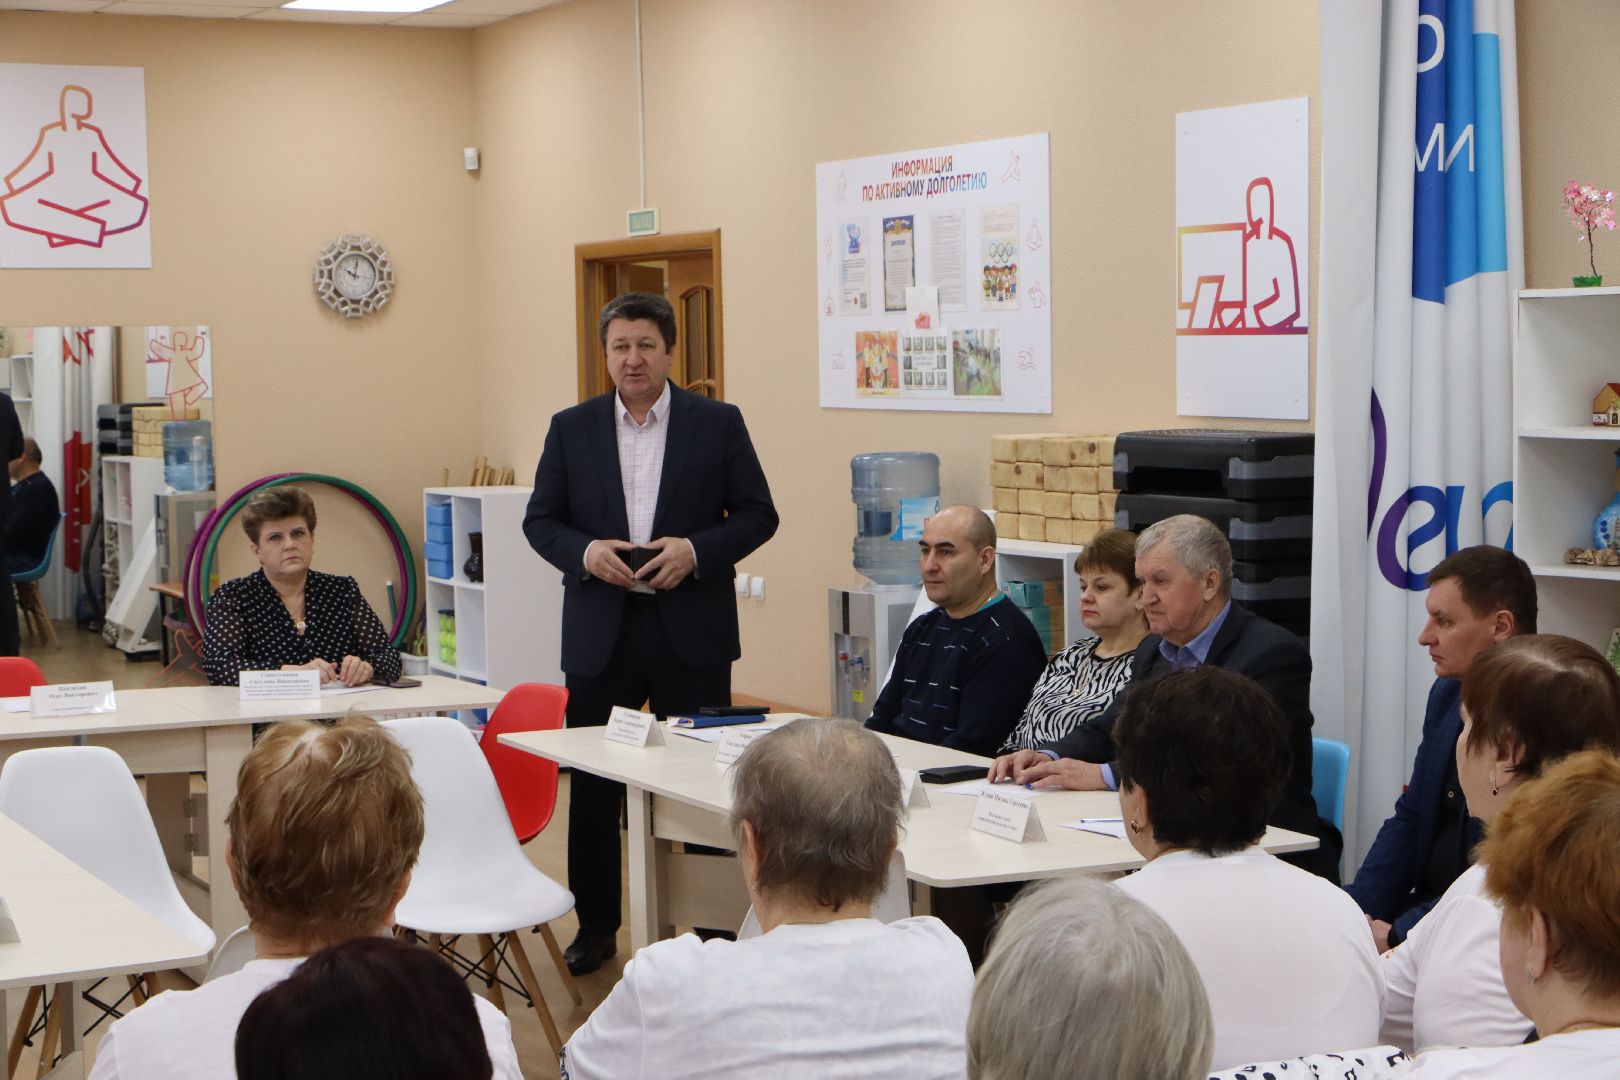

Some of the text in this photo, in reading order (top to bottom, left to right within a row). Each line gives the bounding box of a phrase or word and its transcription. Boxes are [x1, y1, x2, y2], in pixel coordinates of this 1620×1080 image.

[891, 155, 953, 179] ИНФОРМАЦИЯ
[862, 171, 988, 202] ПО АКТИВНОМУ ДОЛГОЛЕТИЮ
